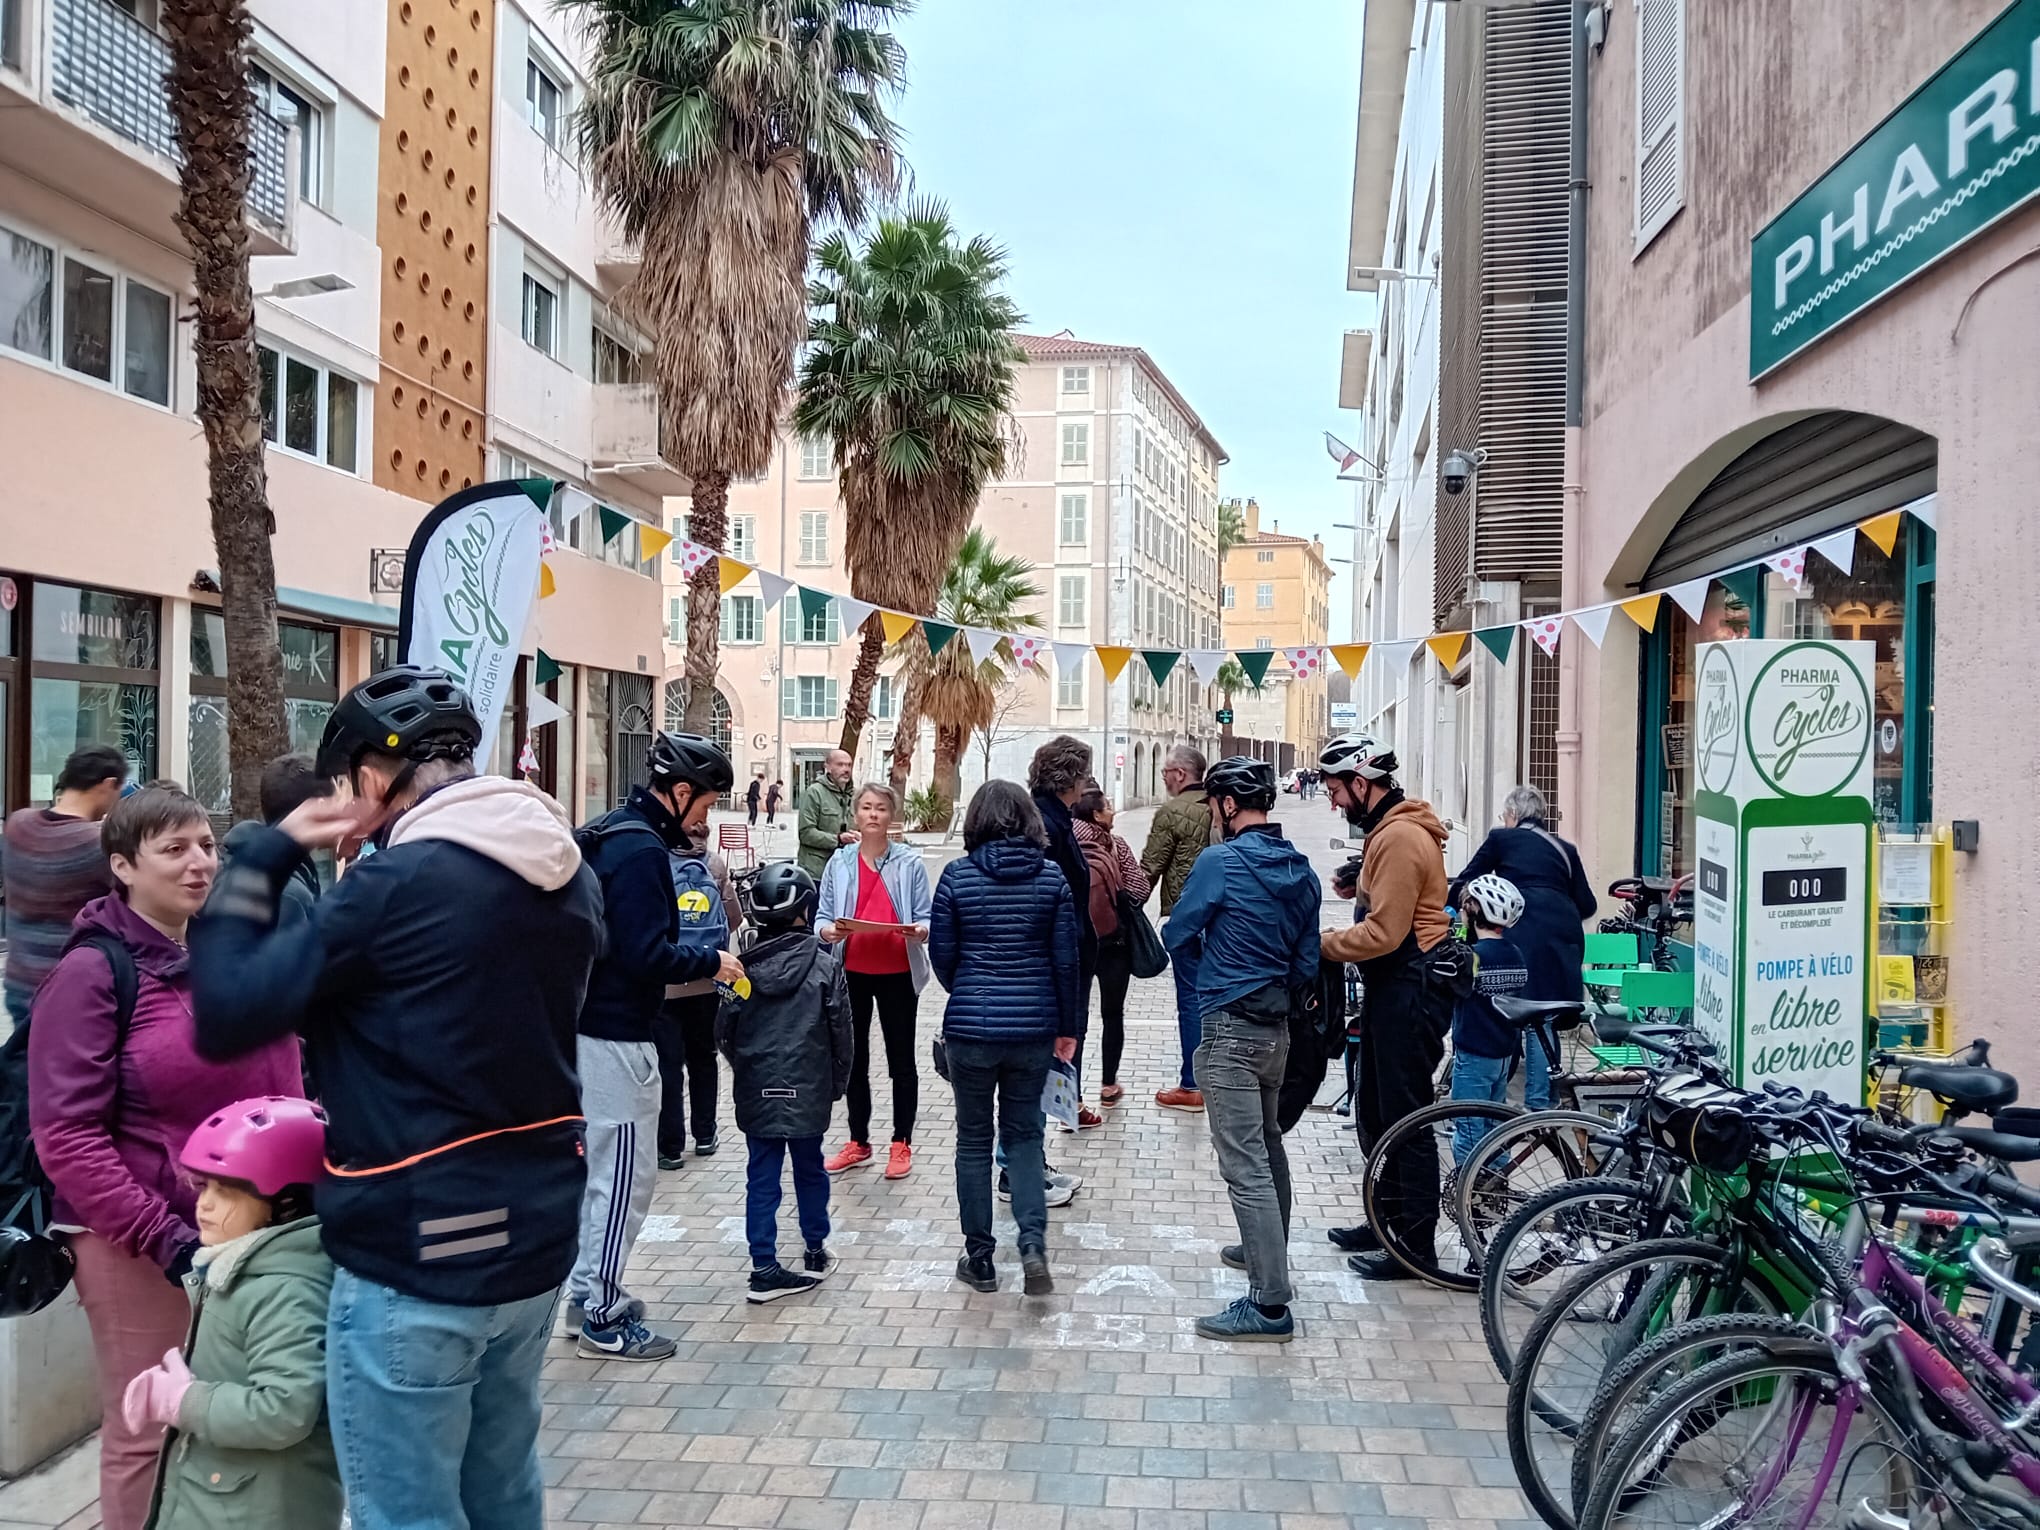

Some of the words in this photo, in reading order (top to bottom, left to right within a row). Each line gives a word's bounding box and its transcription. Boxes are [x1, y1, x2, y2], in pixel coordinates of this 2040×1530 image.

[1774, 35, 2040, 310] PHAR
[60, 611, 121, 639] SEMBILAN
[479, 652, 502, 714] solidaire
[1706, 669, 1727, 682] PHARMA
[1781, 669, 1840, 683] PHARMA
[1773, 684, 1864, 781] Cycles
[1354, 748, 1367, 764] 27
[1789, 878, 1821, 898] 000
[687, 899, 698, 911] 7
[1768, 911, 1776, 919] LE
[1777, 909, 1816, 918] CARBURANT
[1817, 907, 1844, 915] GRATUIT
[1780, 922, 1789, 930] ET
[1757, 960, 1804, 981] POMPE
[1808, 954, 1816, 977] À
[1821, 952, 1853, 976] VÉLO
[1751, 1023, 1767, 1035] en
[1770, 985, 1842, 1031] libre
[1752, 1036, 1856, 1076] service
[1934, 1310, 1996, 1366] Country
